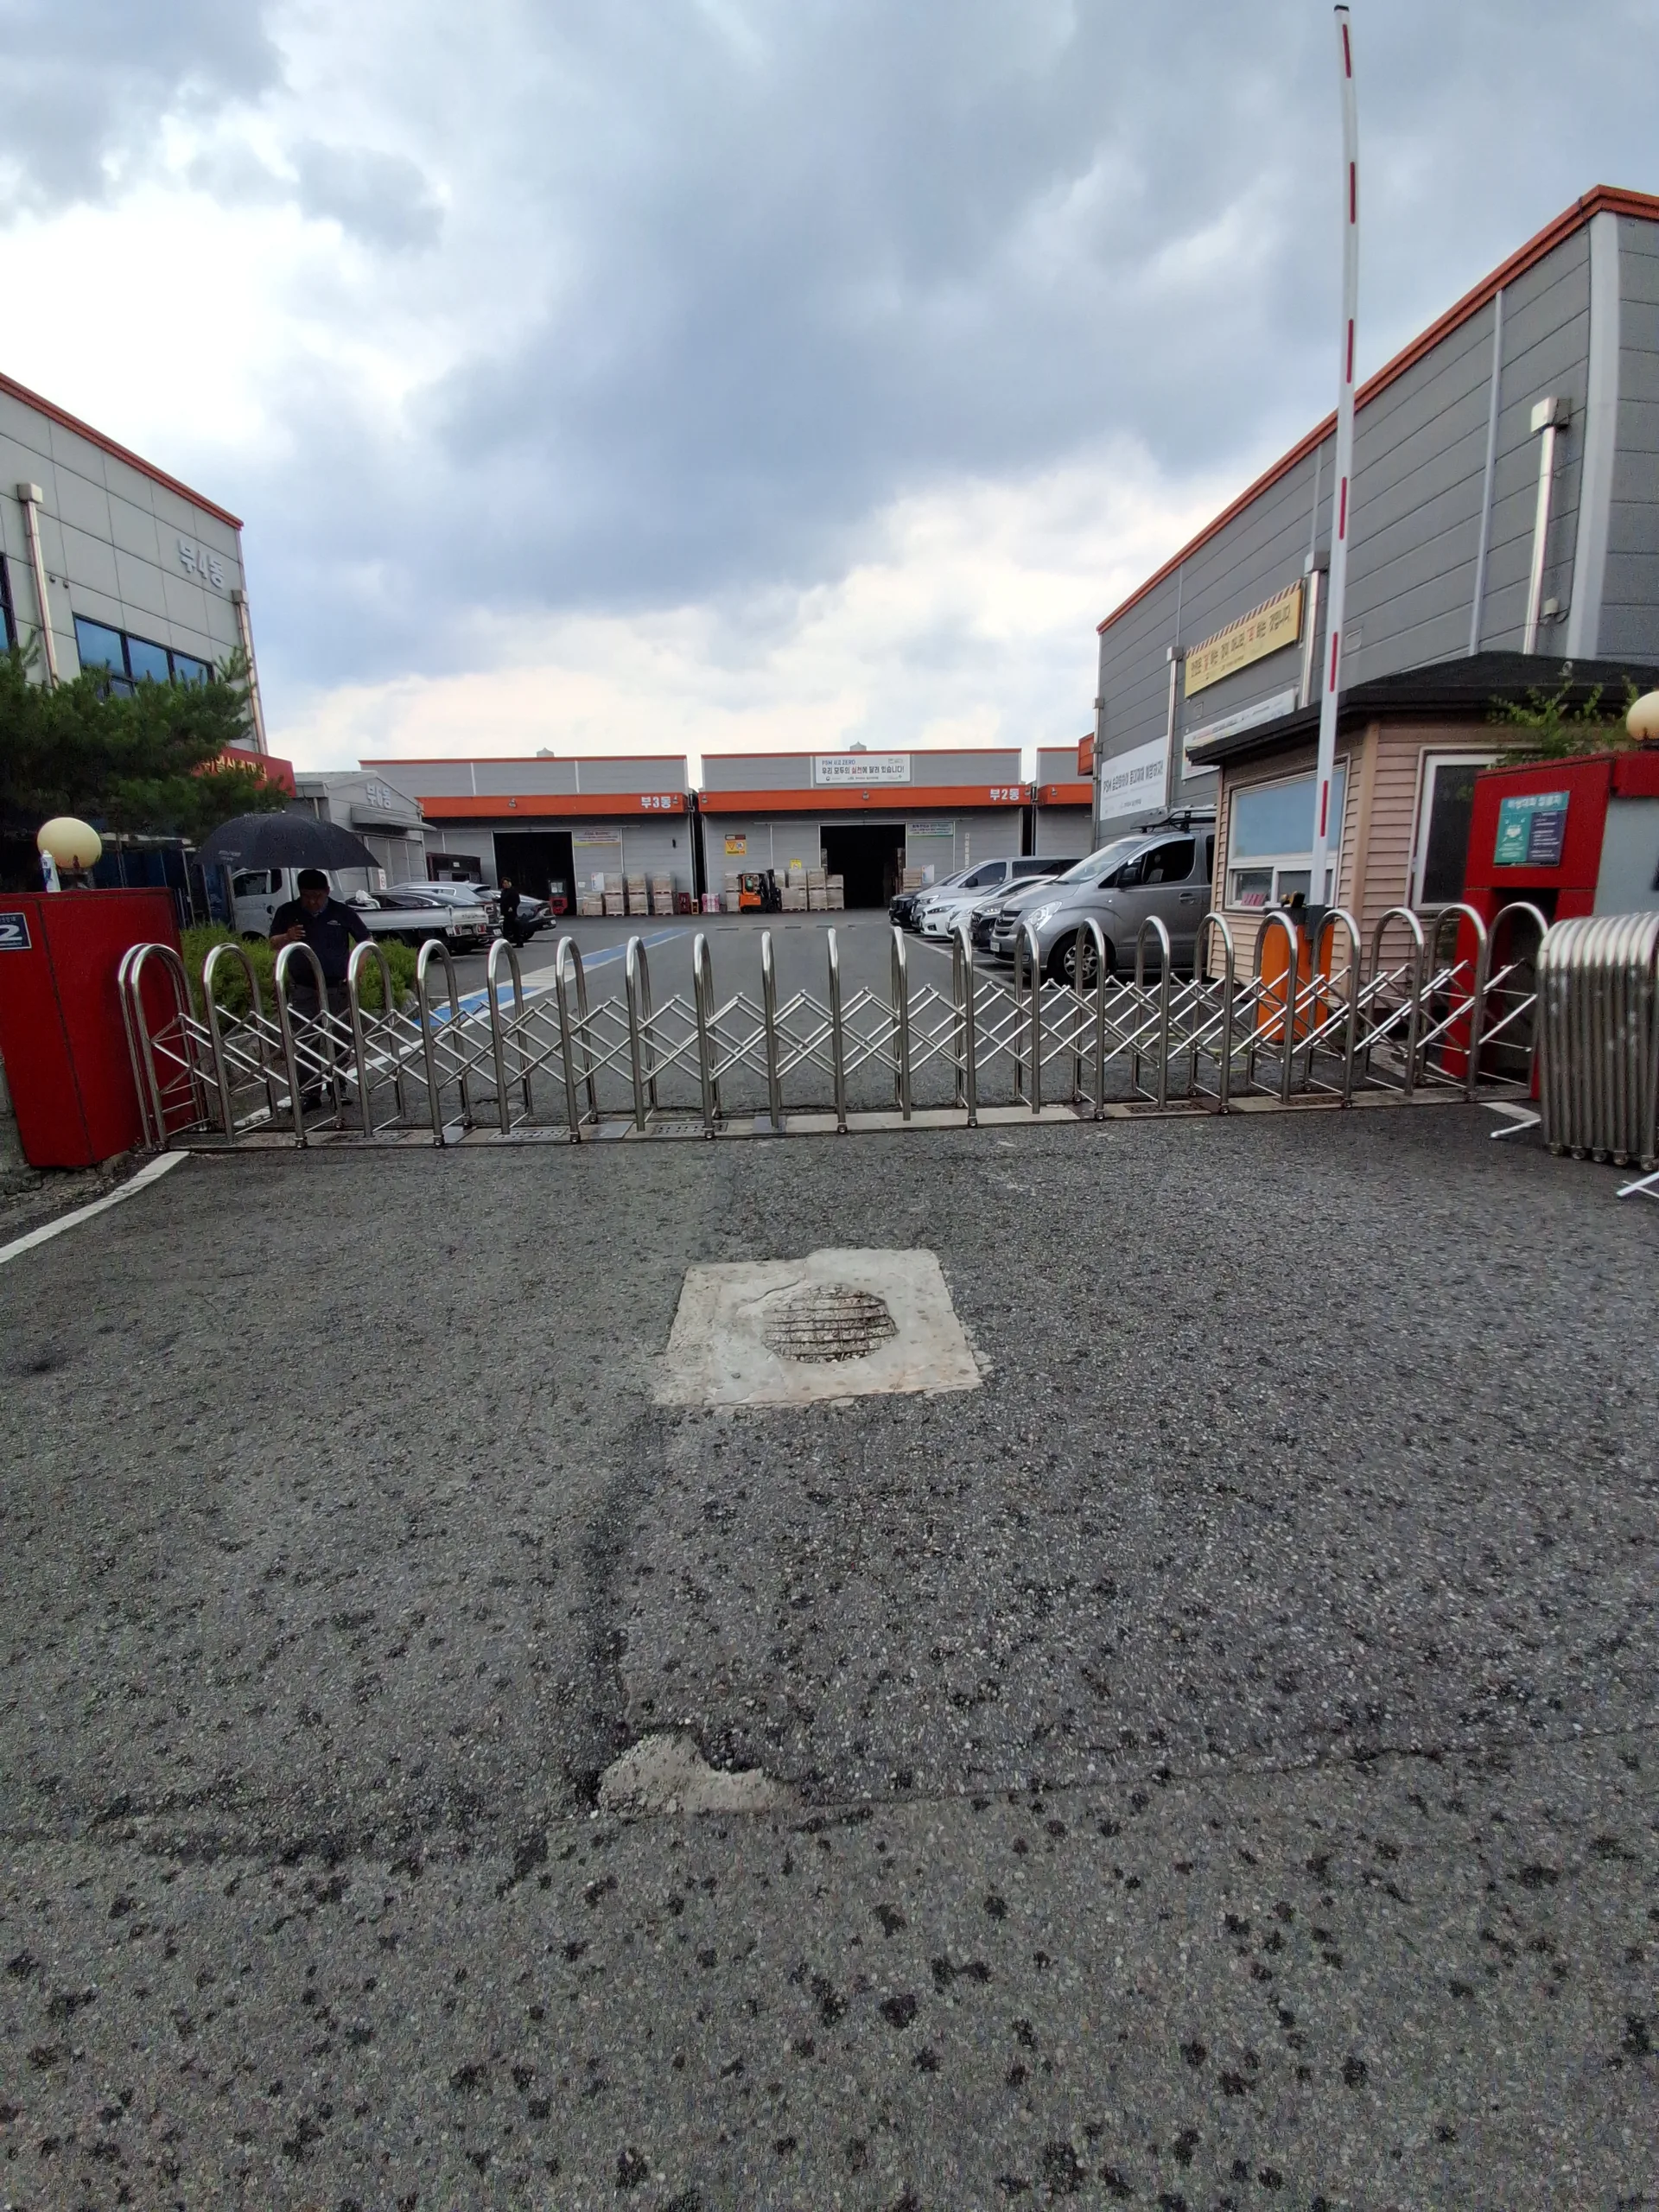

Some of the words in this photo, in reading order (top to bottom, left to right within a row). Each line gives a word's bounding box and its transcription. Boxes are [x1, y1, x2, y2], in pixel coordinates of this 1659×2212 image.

[177, 539, 225, 589] 부4동
[366, 782, 391, 810] 부6동
[641, 796, 671, 809] 부3동
[989, 788, 1020, 801] 부2동
